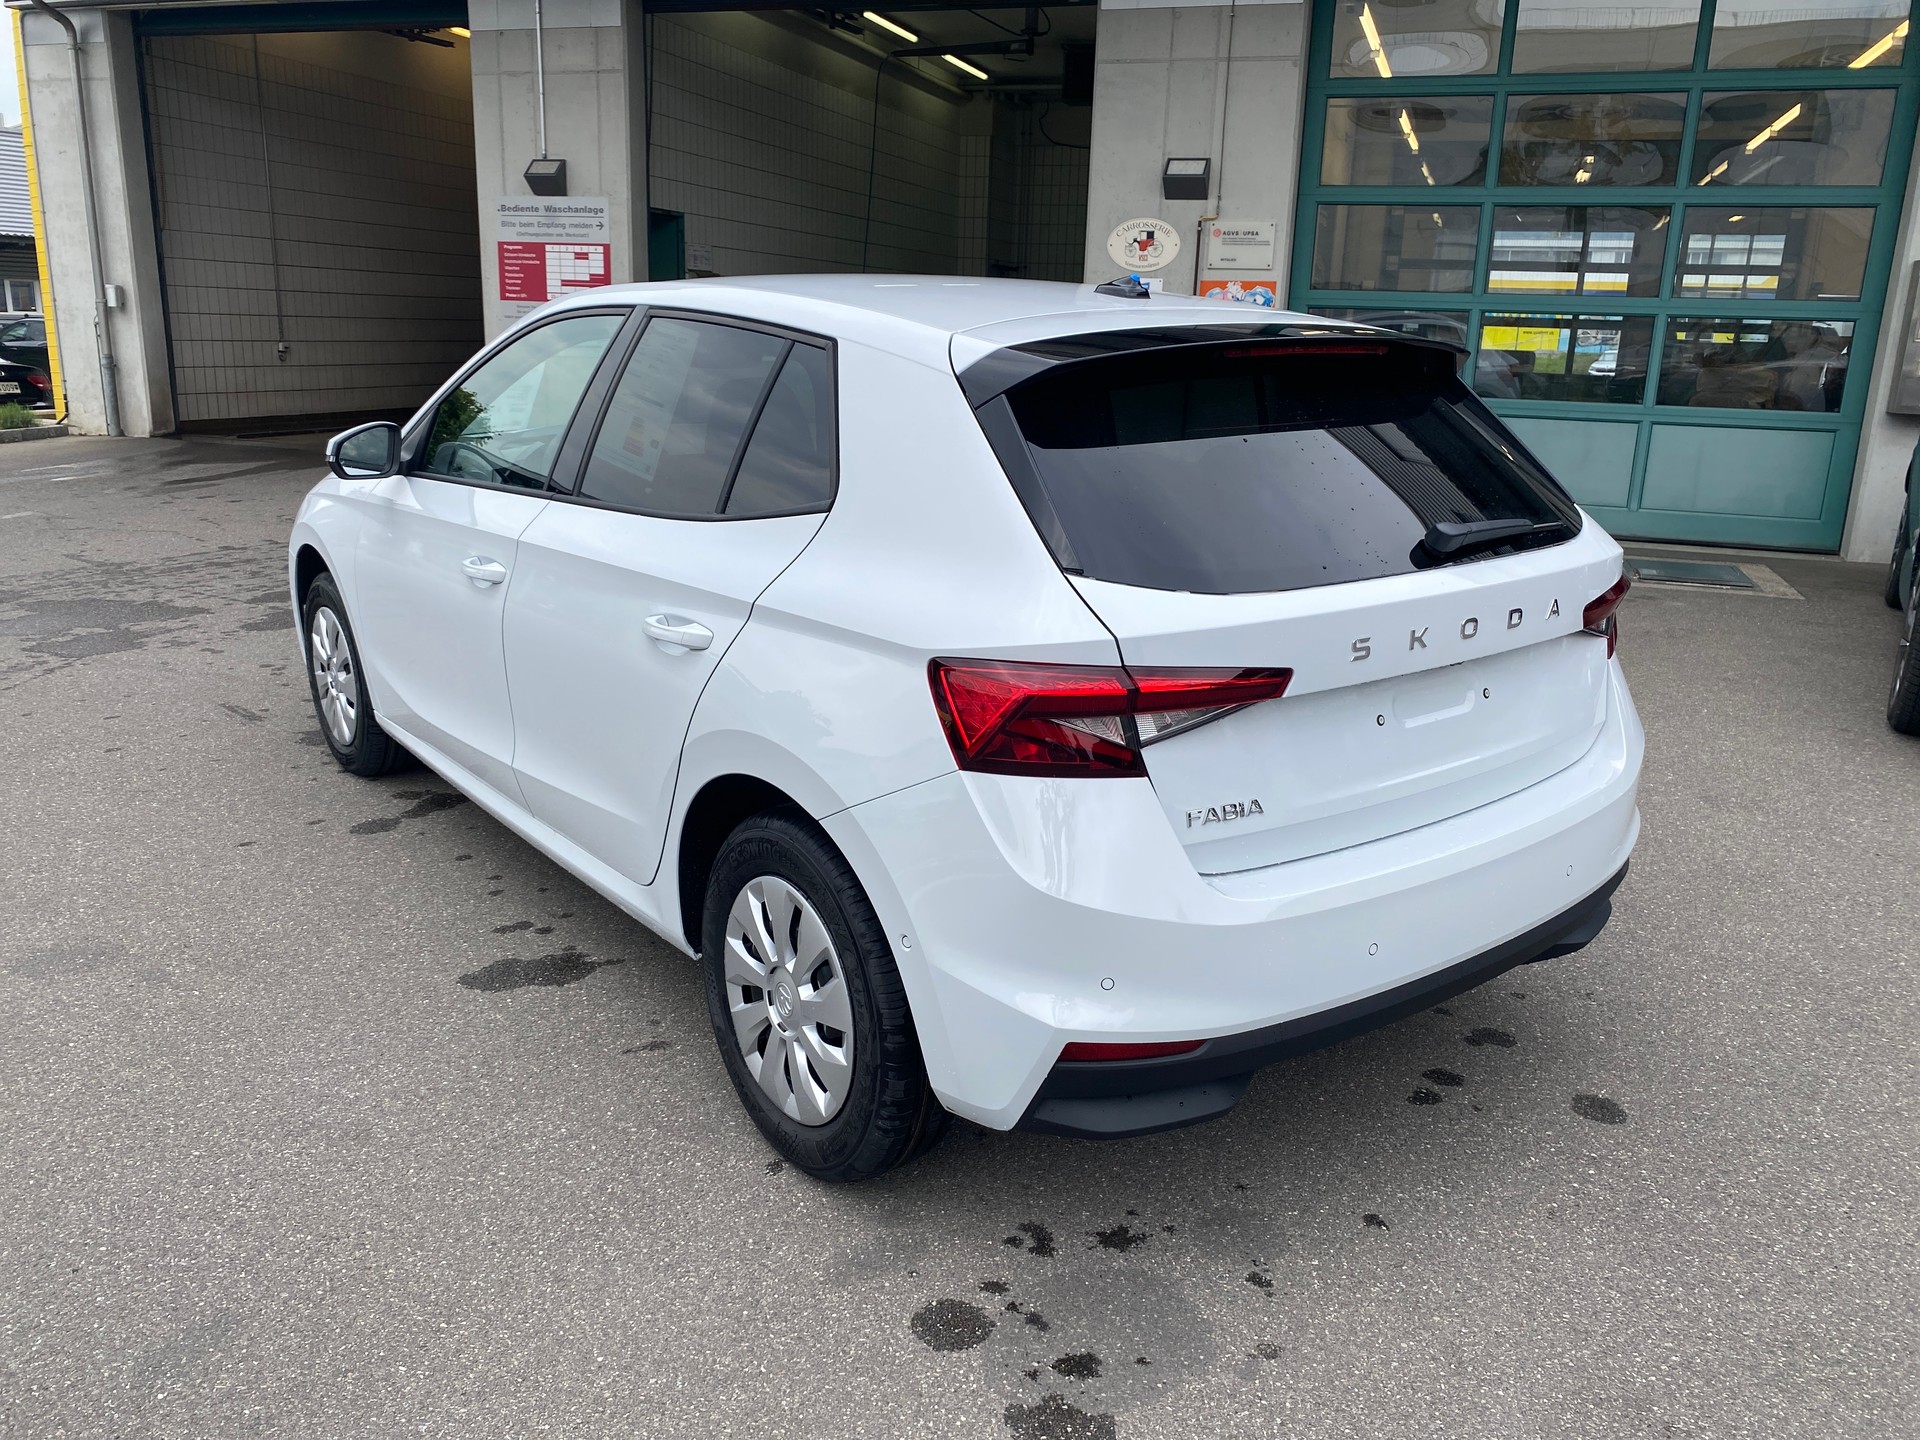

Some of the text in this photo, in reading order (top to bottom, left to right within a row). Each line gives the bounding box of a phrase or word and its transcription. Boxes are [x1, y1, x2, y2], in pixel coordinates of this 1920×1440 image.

[500, 204, 604, 216] Bediente Waschanlage
[501, 220, 517, 228] Bitte
[518, 221, 535, 229] beim
[537, 221, 567, 231] Empfang
[1115, 221, 1173, 238] CARROSSERIE
[0, 383, 15, 392] 009
[1350, 598, 1560, 663] SKODA
[1185, 799, 1265, 829] FABIA
